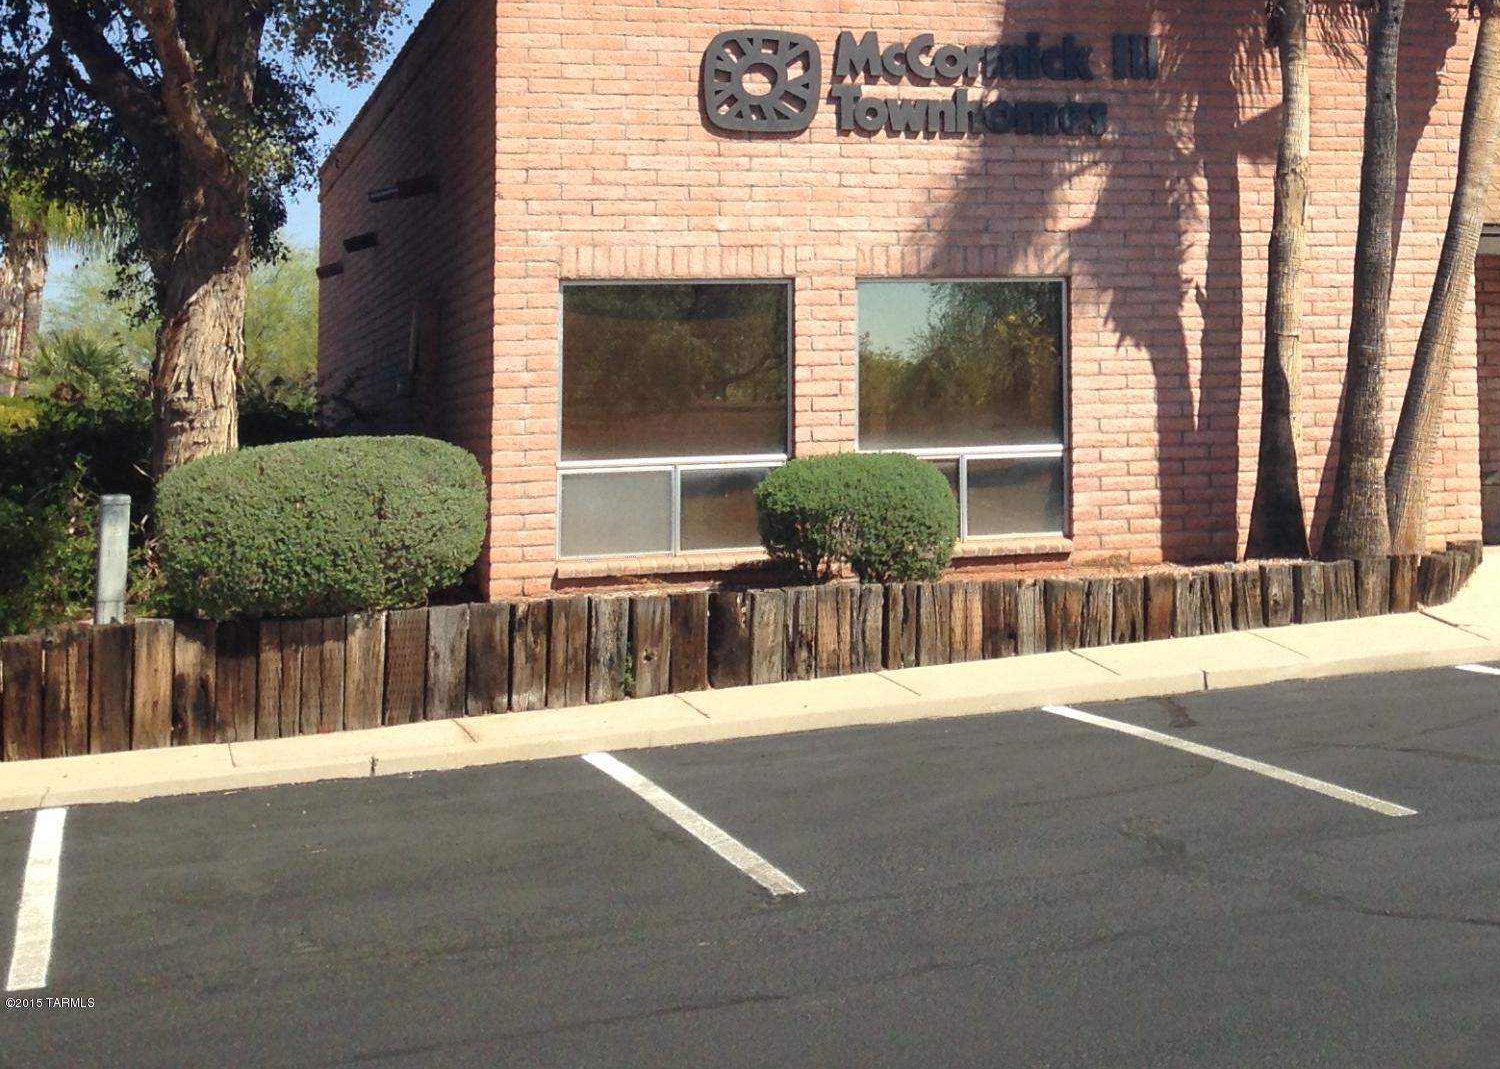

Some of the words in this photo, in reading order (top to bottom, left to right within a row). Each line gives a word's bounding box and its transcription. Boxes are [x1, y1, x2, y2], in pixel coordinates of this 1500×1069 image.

[836, 30, 1093, 80] McCormick
[1112, 34, 1158, 79] III
[832, 84, 1107, 135] Townhomes
